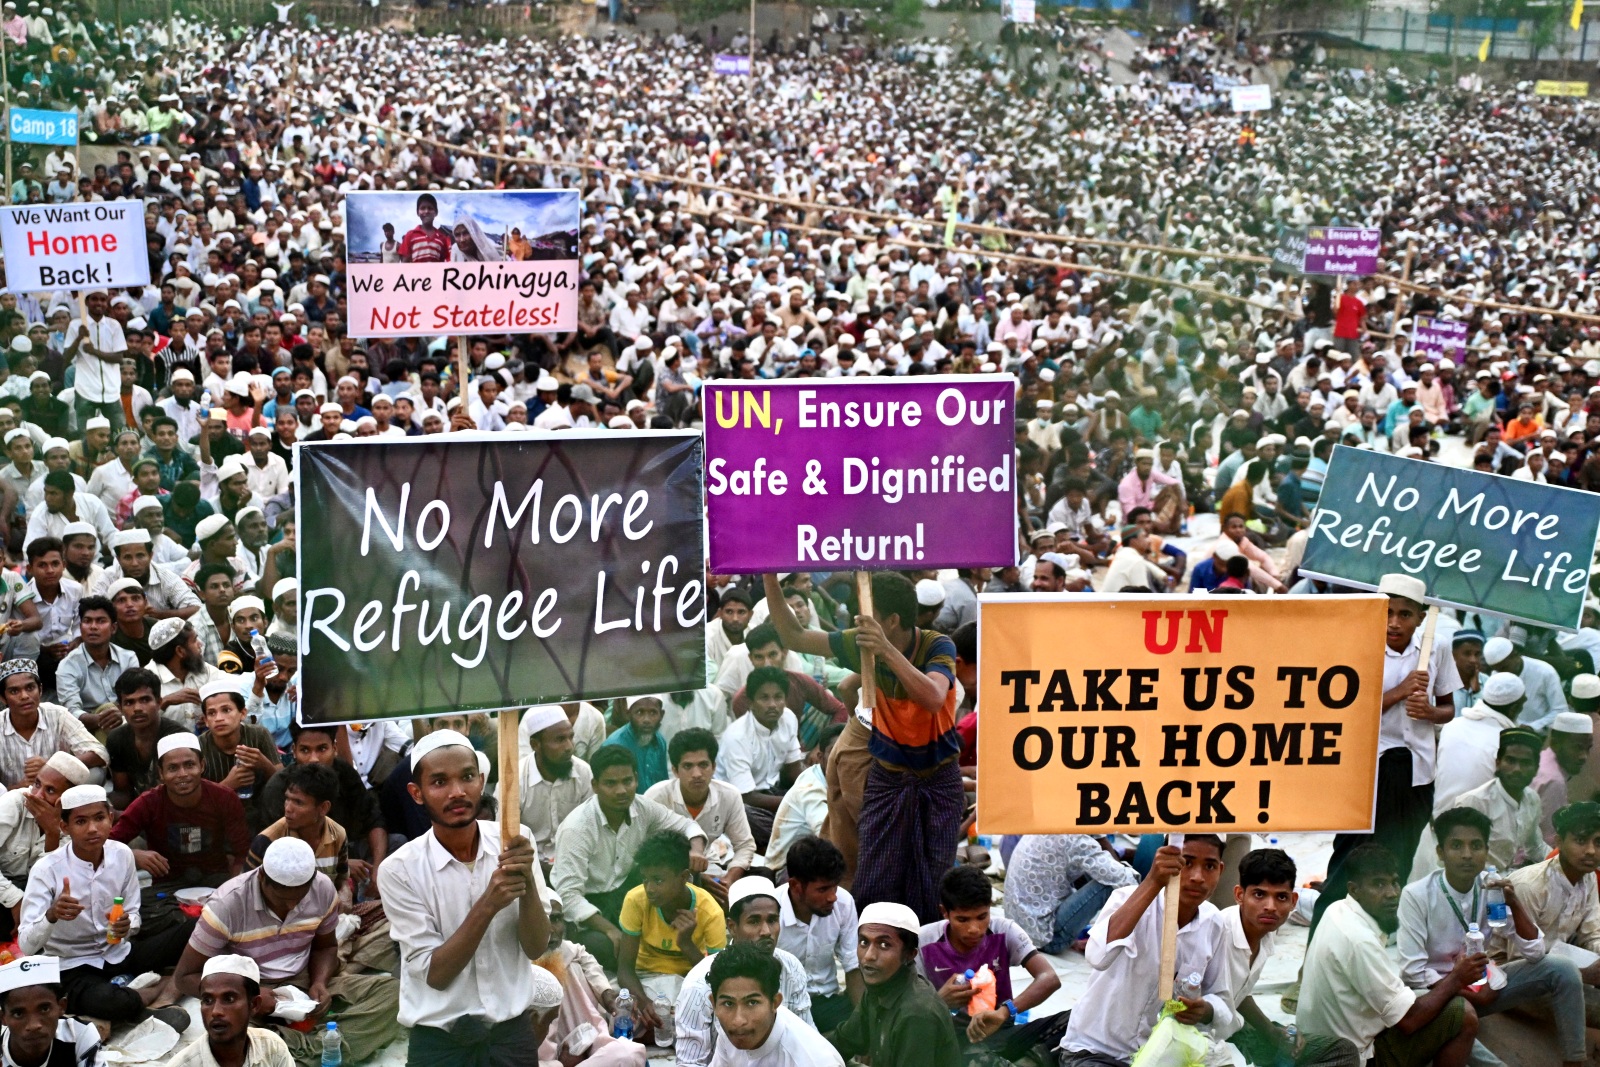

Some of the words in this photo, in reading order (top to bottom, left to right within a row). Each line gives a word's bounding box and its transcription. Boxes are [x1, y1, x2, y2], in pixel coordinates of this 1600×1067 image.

[11, 113, 56, 140] Camp
[60, 118, 77, 138] 18
[11, 209, 41, 225] We
[44, 208, 91, 224] Want
[94, 206, 126, 221] Our
[1328, 229, 1359, 241] Ensure
[1360, 229, 1378, 242] Our
[26, 230, 118, 257] Home
[1305, 243, 1326, 255] Safe
[1337, 244, 1379, 259] Dignified
[39, 263, 100, 287] Back
[351, 273, 385, 294] We
[392, 273, 432, 293] Are
[442, 264, 577, 299] Rohingya,
[1324, 259, 1358, 272] Return!
[369, 305, 422, 331] Not
[432, 299, 561, 330] Stateless!
[715, 390, 783, 435] UN,
[798, 389, 922, 428] Ensure
[935, 387, 1006, 427] Our
[708, 457, 789, 496] Safe
[801, 458, 829, 496] &
[843, 453, 1010, 504] Dignified
[360, 481, 451, 557] No
[484, 478, 654, 549] More
[1355, 472, 1420, 512] No
[1437, 487, 1560, 540] More
[797, 522, 925, 562] Return!
[1308, 507, 1482, 574] Refugee
[1501, 549, 1587, 594] Life
[301, 569, 562, 669] Refugee
[594, 554, 704, 635] Life
[1141, 608, 1229, 655] UN
[1000, 664, 1160, 714] TAKE
[1180, 664, 1256, 712] US
[1276, 664, 1361, 710] TO
[1012, 724, 1141, 771] OUR
[1158, 722, 1343, 768] HOME
[1075, 779, 1236, 826] BACK
